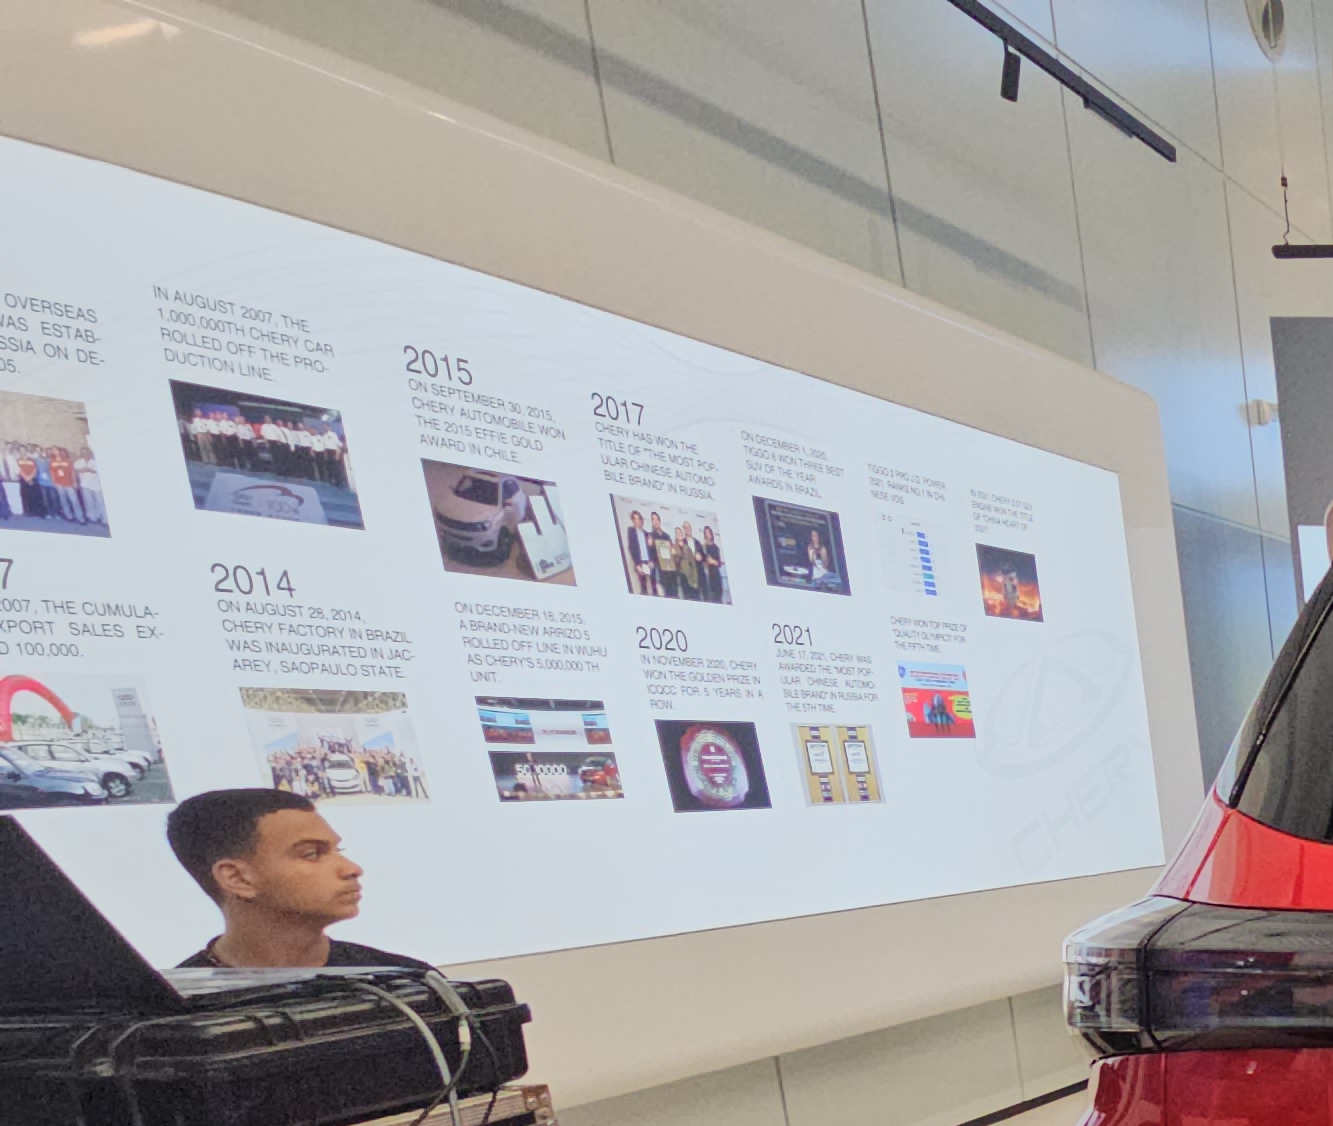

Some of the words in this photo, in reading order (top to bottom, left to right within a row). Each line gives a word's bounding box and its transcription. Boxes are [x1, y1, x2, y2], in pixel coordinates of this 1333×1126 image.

[4, 293, 97, 323] OVERSEAS
[153, 285, 169, 300] IN
[173, 290, 236, 315] AUGUST
[280, 314, 311, 333] THE
[40, 321, 102, 343] ESTAB-
[249, 326, 299, 349] CHERY
[304, 339, 334, 357] CAR
[43, 343, 68, 360] ON
[76, 349, 104, 365] DE-
[160, 327, 222, 351] ROLLED
[227, 341, 256, 357] OFF
[260, 348, 290, 366] THE
[163, 348, 235, 374] DUCTION
[403, 345, 473, 385] 2015
[408, 378, 428, 392] ON
[430, 384, 505, 409] SEPTEMBER
[412, 397, 456, 415] CHERY
[460, 408, 536, 434] AUTOMOBILE
[537, 425, 566, 440] WON
[591, 392, 644, 425] 2017
[415, 414, 441, 430] THE
[444, 421, 472, 437] 2015
[474, 427, 509, 444] EFFIE
[511, 435, 543, 451] GOLD
[420, 433, 465, 452] AWARD
[469, 443, 481, 456] IN
[595, 422, 630, 437] CHERY
[633, 430, 653, 444] HAS
[655, 436, 678, 449] WON
[680, 441, 698, 454] THE
[597, 437, 626, 453] TITLE
[628, 445, 641, 456] OF
[668, 454, 694, 468] MOST
[600, 454, 628, 469] ULAR
[630, 460, 673, 478] CHINESE
[604, 470, 626, 484] BILE
[668, 483, 677, 493] IN
[0, 558, 13, 590] 7
[211, 563, 296, 598] 2014
[41, 599, 77, 615] THE
[82, 602, 159, 619] CUMULA-
[217, 599, 240, 613] ON
[245, 602, 304, 618] AUGUST
[454, 602, 473, 614] ON
[475, 604, 540, 620] DECEMBER
[69, 622, 124, 637] SALES
[136, 625, 164, 639] EX-
[222, 619, 273, 634] CHERY
[278, 623, 344, 638] FACTORY
[349, 628, 362, 640] IN
[366, 630, 412, 644] BRAZIL
[460, 620, 467, 630] A
[543, 627, 582, 639] ARRIZO
[584, 630, 590, 640] 5
[636, 626, 688, 652] 2020
[772, 624, 812, 646] 2021
[226, 639, 262, 653] WAS
[266, 641, 367, 659] INAUGURATED
[372, 649, 384, 660] IN
[462, 637, 509, 650] ROLLED
[511, 640, 533, 652] OFF
[536, 642, 561, 654] LINE
[563, 645, 573, 655] IN
[467, 654, 482, 665] AS
